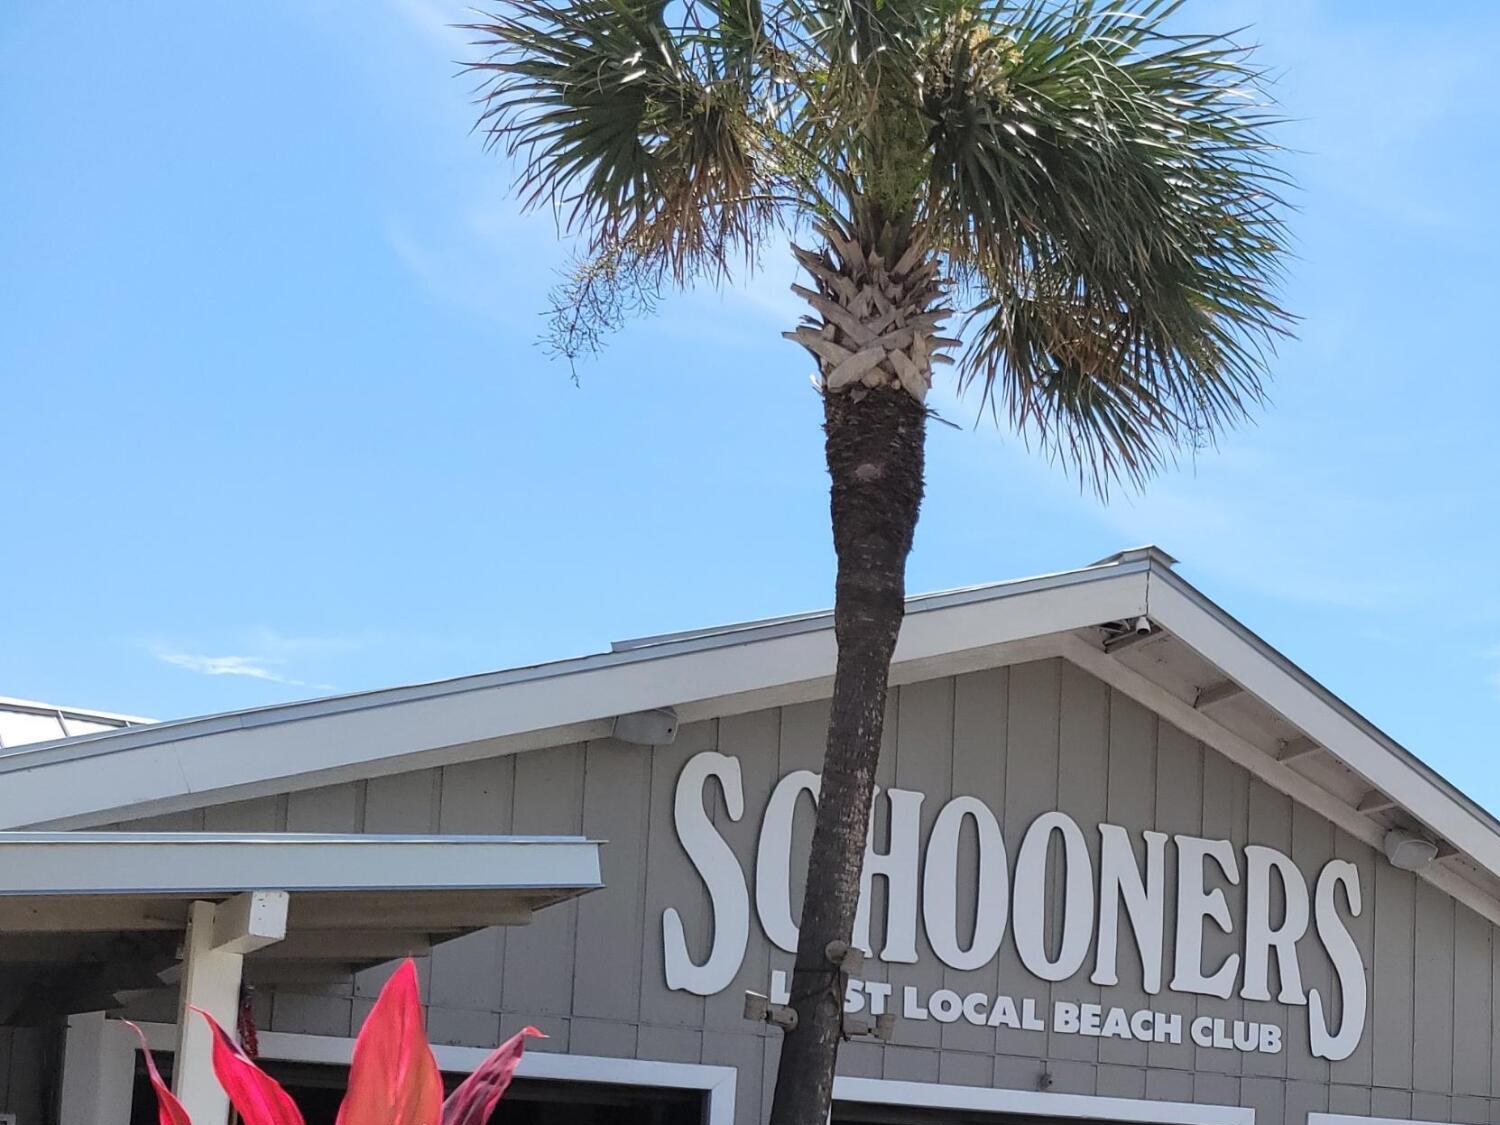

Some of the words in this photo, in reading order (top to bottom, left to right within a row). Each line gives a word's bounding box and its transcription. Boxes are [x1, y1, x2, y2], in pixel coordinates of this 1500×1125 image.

[663, 751, 1367, 1061] SCHOONERS
[770, 969, 892, 1015] LST
[903, 986, 1044, 1031] LOCAL
[1053, 1001, 1182, 1044] BEACH
[1190, 1016, 1282, 1053] CLUB
